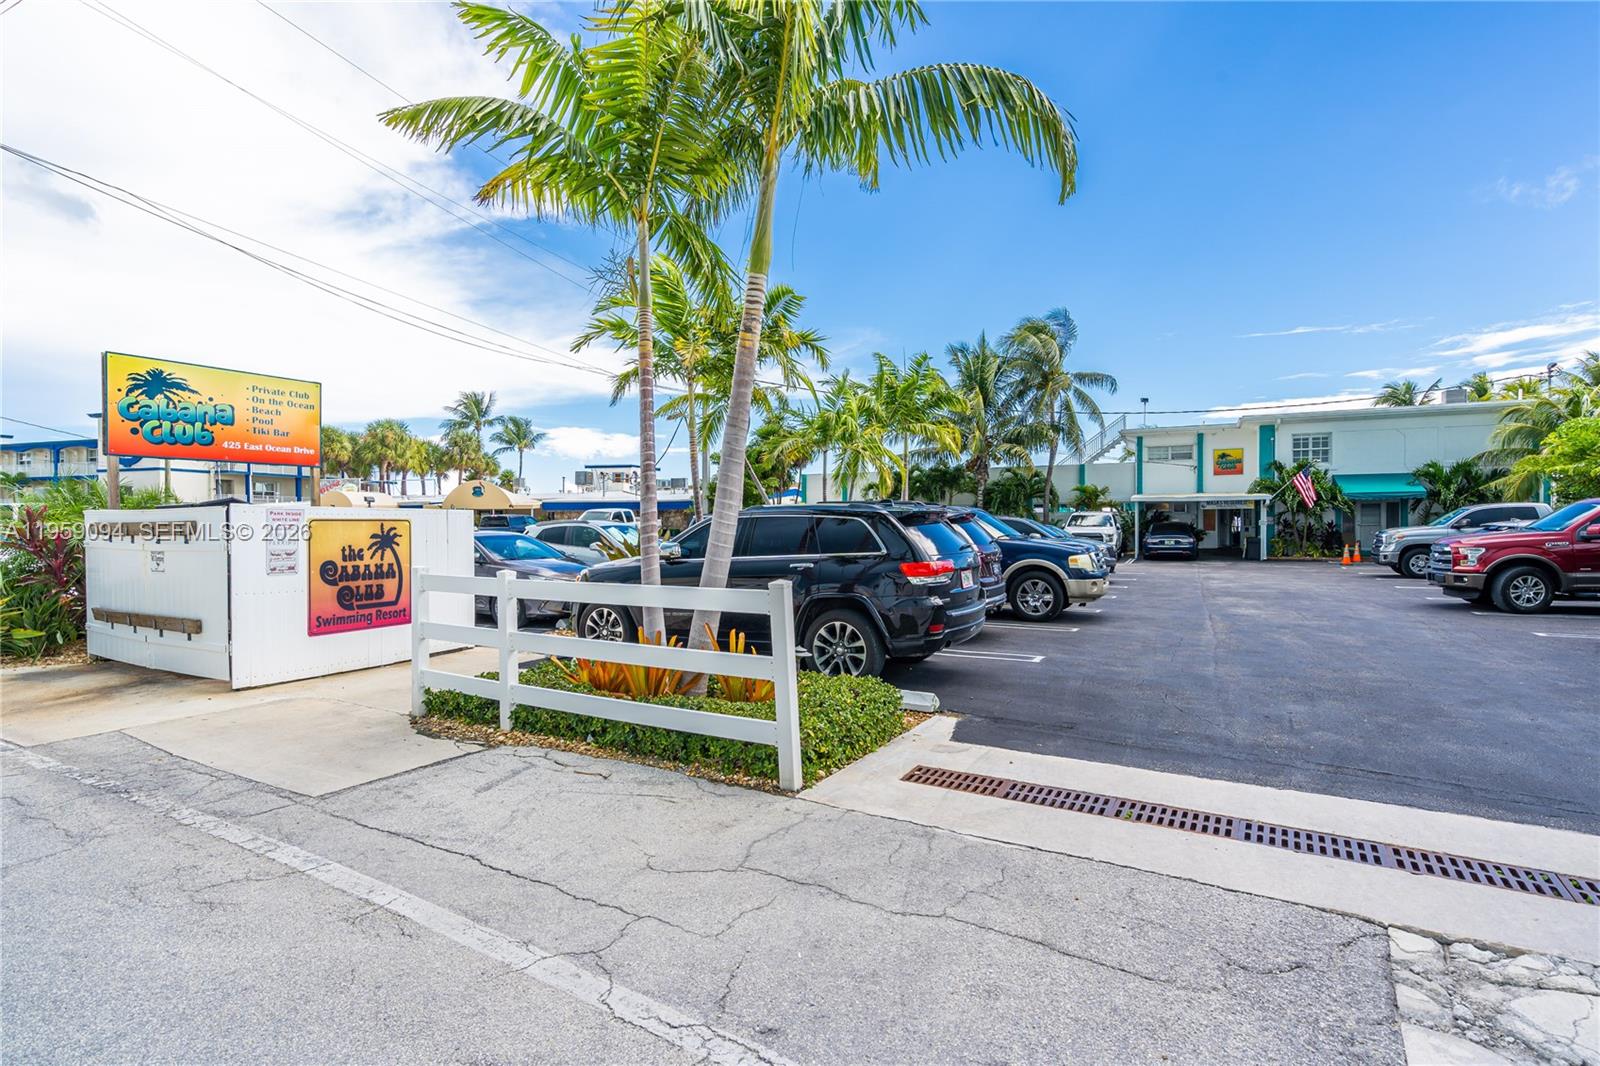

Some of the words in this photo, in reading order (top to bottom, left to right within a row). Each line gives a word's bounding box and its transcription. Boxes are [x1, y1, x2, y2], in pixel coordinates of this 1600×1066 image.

[251, 384, 286, 396] Private
[288, 390, 310, 400] Club
[117, 395, 236, 427] Cabana
[251, 395, 265, 405] On
[268, 397, 284, 406] the
[286, 399, 315, 411] Ocean
[251, 405, 282, 416] Beach
[251, 416, 274, 426] Pool
[142, 419, 215, 447] Club
[252, 427, 270, 435] Tiki
[273, 429, 290, 437] Bar
[221, 440, 241, 450] 425
[243, 441, 263, 451] East
[264, 444, 292, 453] Ocean
[293, 446, 315, 455] Drive
[341, 545, 364, 562] the
[315, 611, 373, 628] Swimming
[375, 607, 407, 620] Resort
